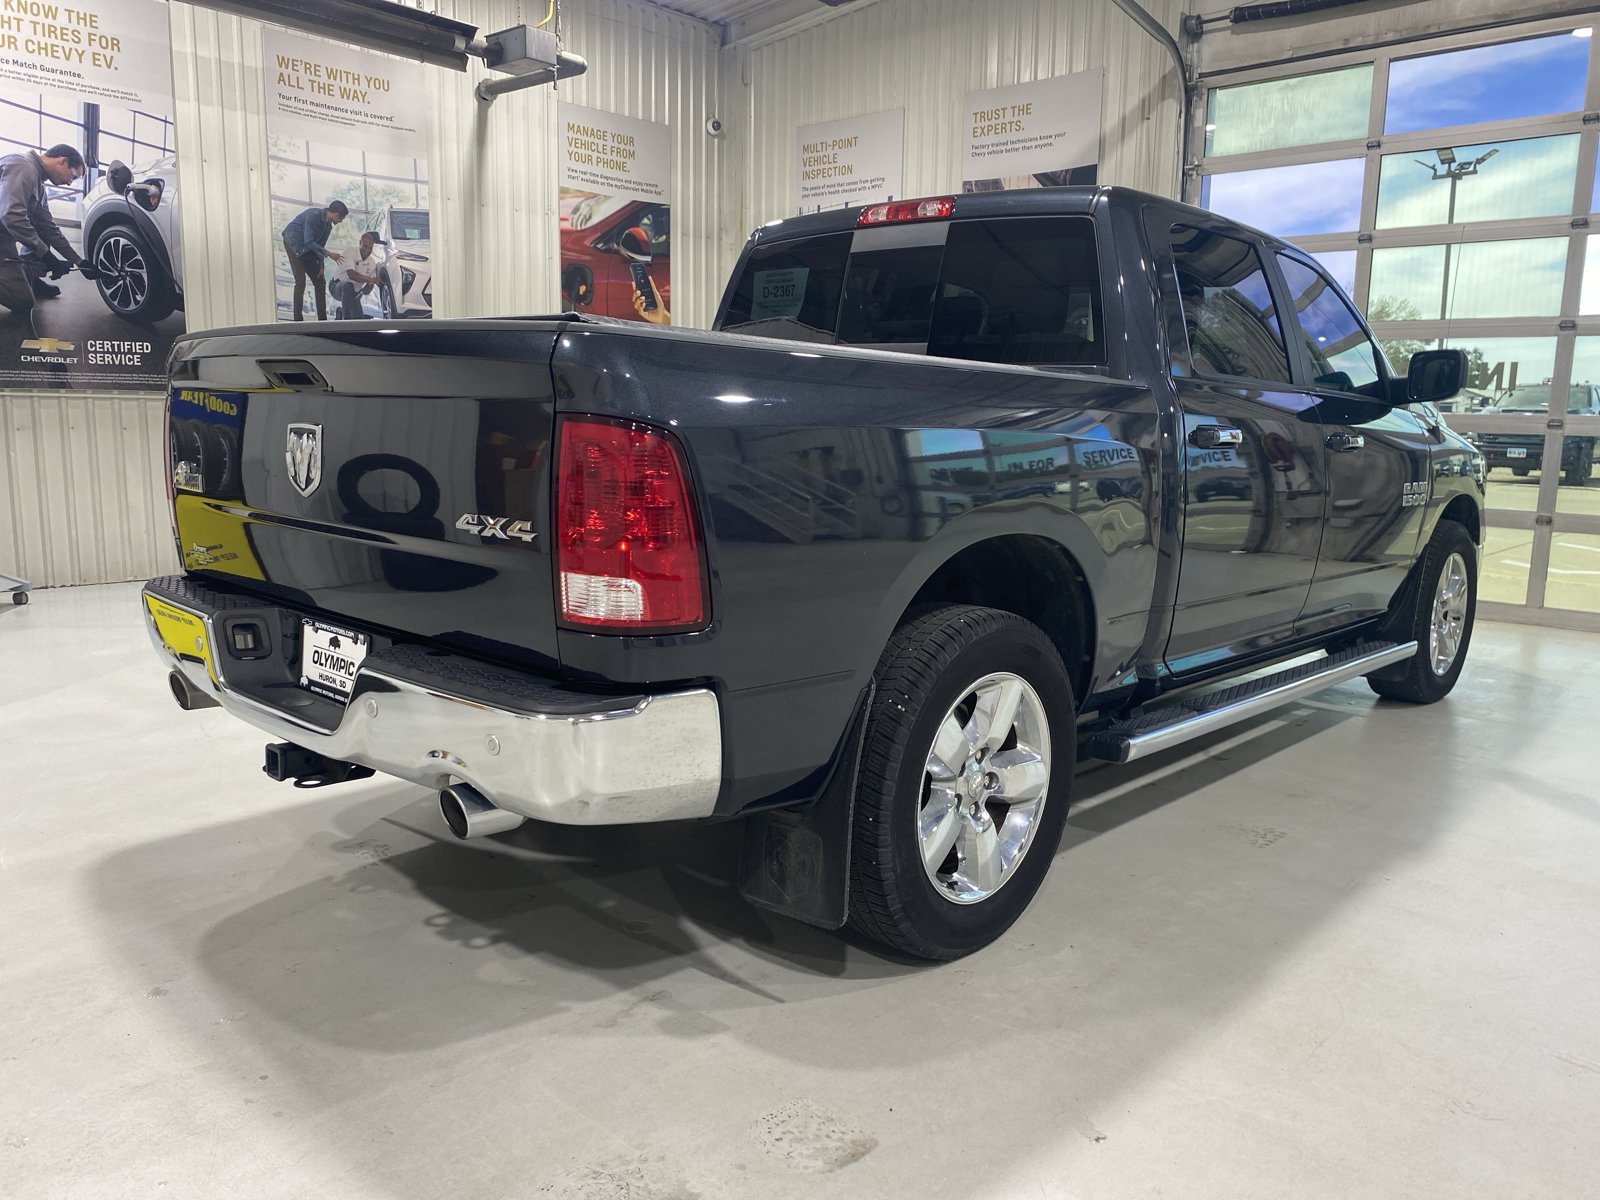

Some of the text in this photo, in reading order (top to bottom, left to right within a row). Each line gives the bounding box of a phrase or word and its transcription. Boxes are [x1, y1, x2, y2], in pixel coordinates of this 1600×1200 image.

[4, 0, 99, 30] KNOW THE
[30, 21, 81, 44] TIRES
[88, 33, 121, 53] FOR
[25, 39, 86, 64] CHEVY
[92, 52, 118, 71] EV.
[12, 58, 38, 70] Match
[40, 65, 84, 80] Guarantee.
[276, 55, 390, 92] WE'RE WITH YOU
[278, 72, 371, 105] ALL THE WAY.
[278, 92, 292, 101] Your
[294, 96, 308, 106] first
[310, 100, 348, 114] maintenance
[350, 108, 362, 117] visit
[973, 103, 1032, 124] TRUST THE
[567, 122, 635, 147] MANAGE YOUR
[972, 120, 1025, 138] EXPERTS.
[567, 136, 636, 160] VEHICLE FROM
[802, 136, 859, 155] MULTI-POINT
[972, 143, 990, 151] Factory
[1010, 136, 1038, 146] technicians
[1054, 132, 1066, 140] your
[987, 148, 1004, 156] vehicle
[1005, 146, 1020, 154] better
[1034, 142, 1054, 150] anyone.
[567, 150, 630, 173] YOUR PHONE.
[802, 153, 838, 168] VEHICLE
[567, 166, 578, 174] View
[600, 173, 624, 183] diagnostics
[802, 164, 853, 181] INSPECTION
[581, 177, 599, 186] available
[614, 183, 640, 193] myChevrolet
[763, 284, 796, 299] D-2367
[88, 340, 151, 353] CERTIFIED
[21, 355, 78, 364] CHEVROLET
[88, 354, 141, 366] SERVICE
[1083, 448, 1135, 465] SERVICE
[1404, 482, 1428, 494] RAM
[1403, 494, 1427, 507] 1500
[456, 513, 538, 542] 4X4
[313, 650, 355, 677] OLYMPIC
[319, 673, 346, 689] HURON, SD
